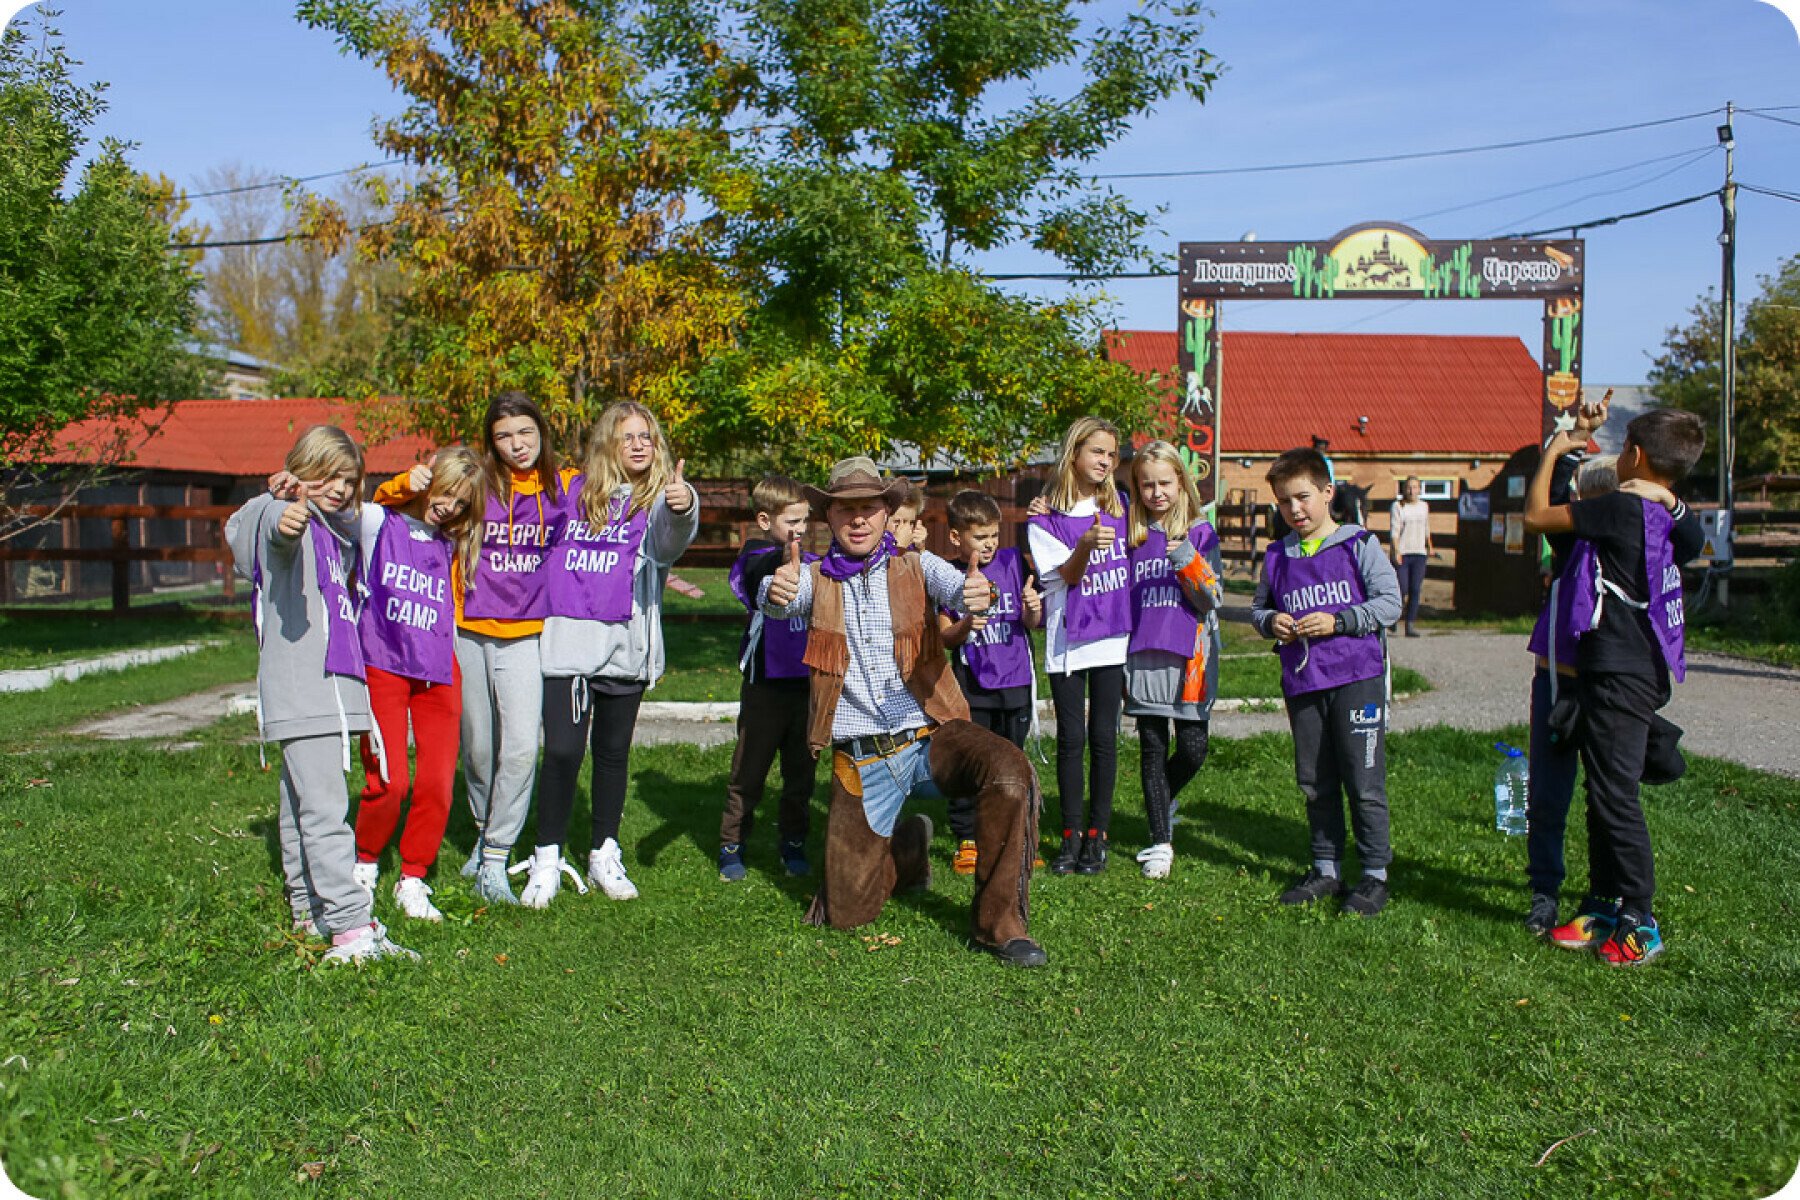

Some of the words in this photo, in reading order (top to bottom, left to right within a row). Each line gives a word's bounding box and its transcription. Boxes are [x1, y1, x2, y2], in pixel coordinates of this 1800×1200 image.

[484, 521, 554, 546] PEOPLE
[490, 551, 542, 573] CAMP
[564, 548, 619, 574] CAMP
[1135, 557, 1173, 583] PEOP
[381, 561, 446, 603] PEOPLE
[1081, 566, 1127, 596] CAMP
[1282, 579, 1353, 613] RANCHO
[386, 596, 438, 631] CAMP
